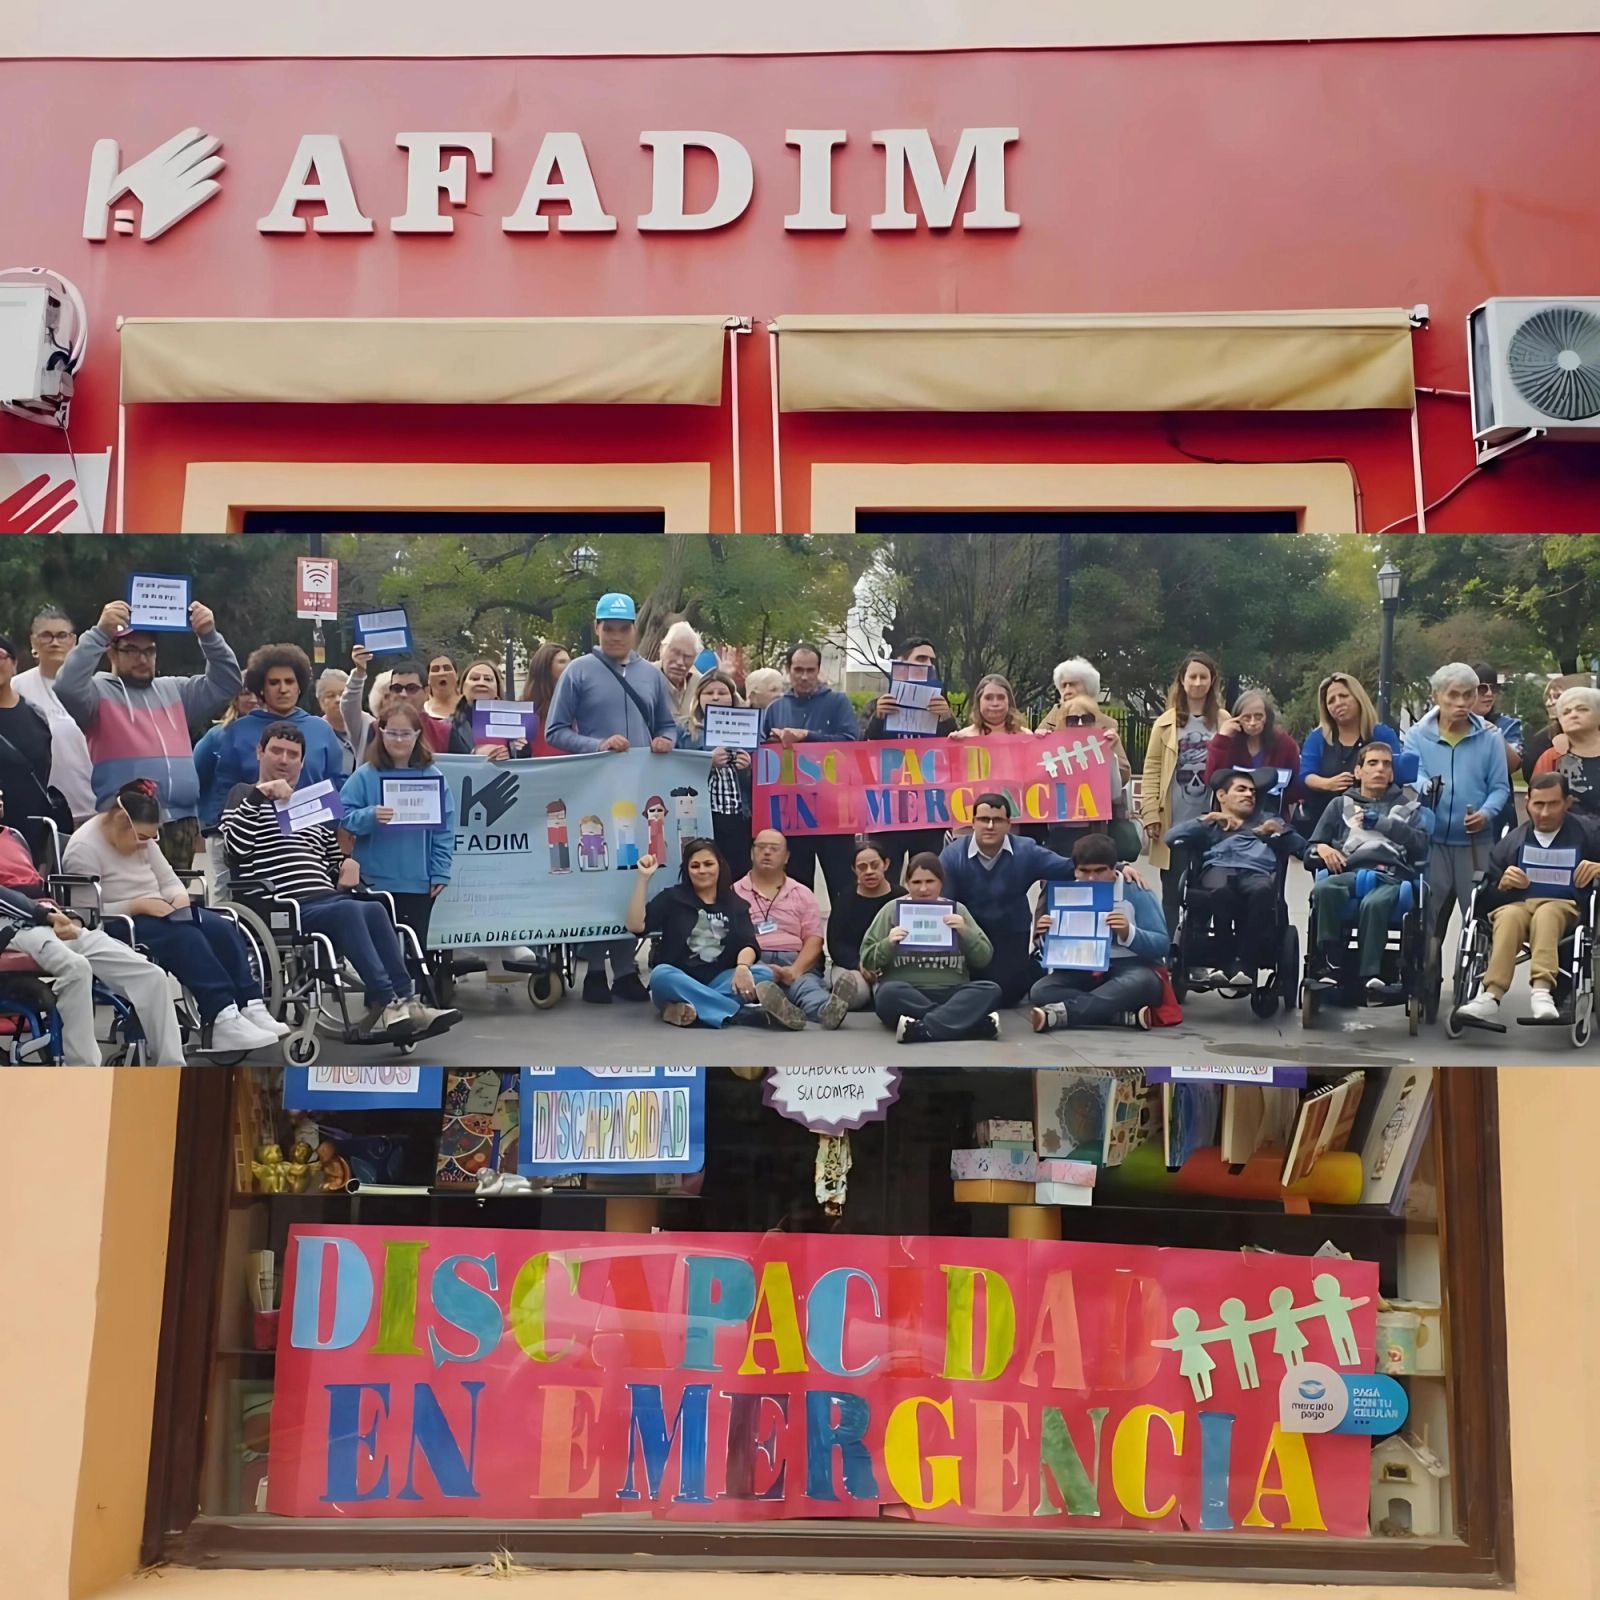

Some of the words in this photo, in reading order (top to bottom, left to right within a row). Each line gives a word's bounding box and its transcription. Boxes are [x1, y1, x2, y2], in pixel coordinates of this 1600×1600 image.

[256, 126, 1022, 235] AFADIM
[756, 745, 1018, 787] DISCAPACID
[769, 792, 819, 831] EN
[837, 782, 1100, 829] EMERGNCIA
[454, 832, 529, 851] FADIM
[440, 932, 481, 945] LINEA
[485, 928, 543, 942] DIRECTA
[547, 928, 556, 939] A
[797, 1085, 814, 1101] SU
[816, 1084, 865, 1100] COMPRA
[535, 1090, 688, 1160] DISCAPACIDAD
[291, 1235, 1167, 1392] DISCAPACIDAD
[1291, 1402, 1334, 1411] mercado
[1300, 1411, 1325, 1420] pago
[320, 1381, 486, 1503] EN
[530, 1383, 1328, 1531] EMERGENCIA
